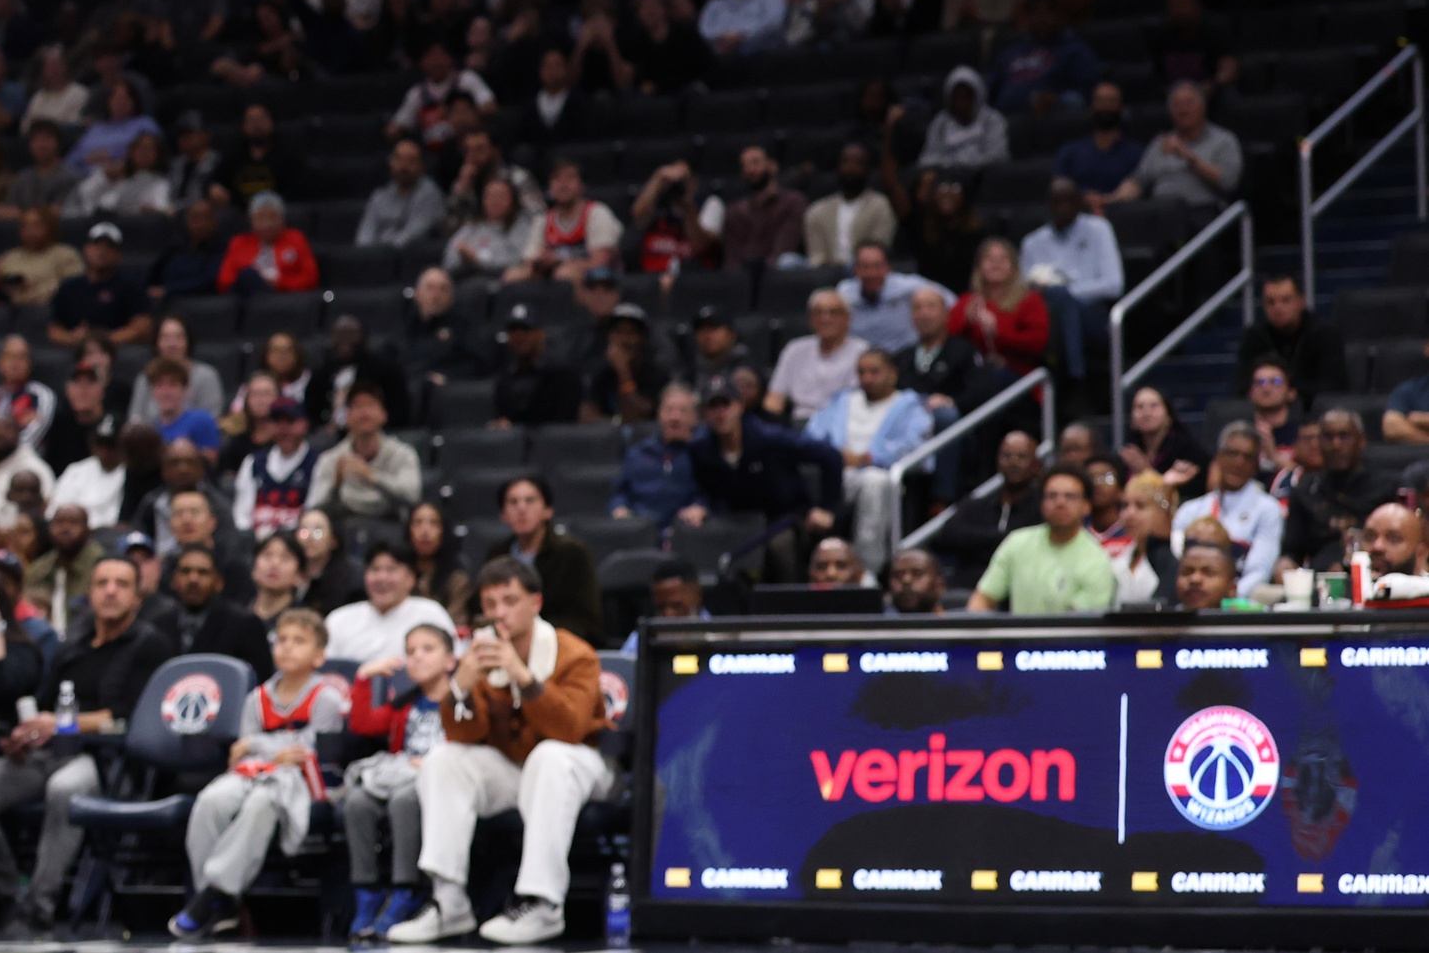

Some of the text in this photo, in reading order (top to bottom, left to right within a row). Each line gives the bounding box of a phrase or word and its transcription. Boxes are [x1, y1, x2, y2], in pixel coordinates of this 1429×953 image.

[1177, 710, 1266, 745] WASHINGTON
[809, 732, 1077, 803] verizon
[1186, 797, 1257, 825] WIZARDS
